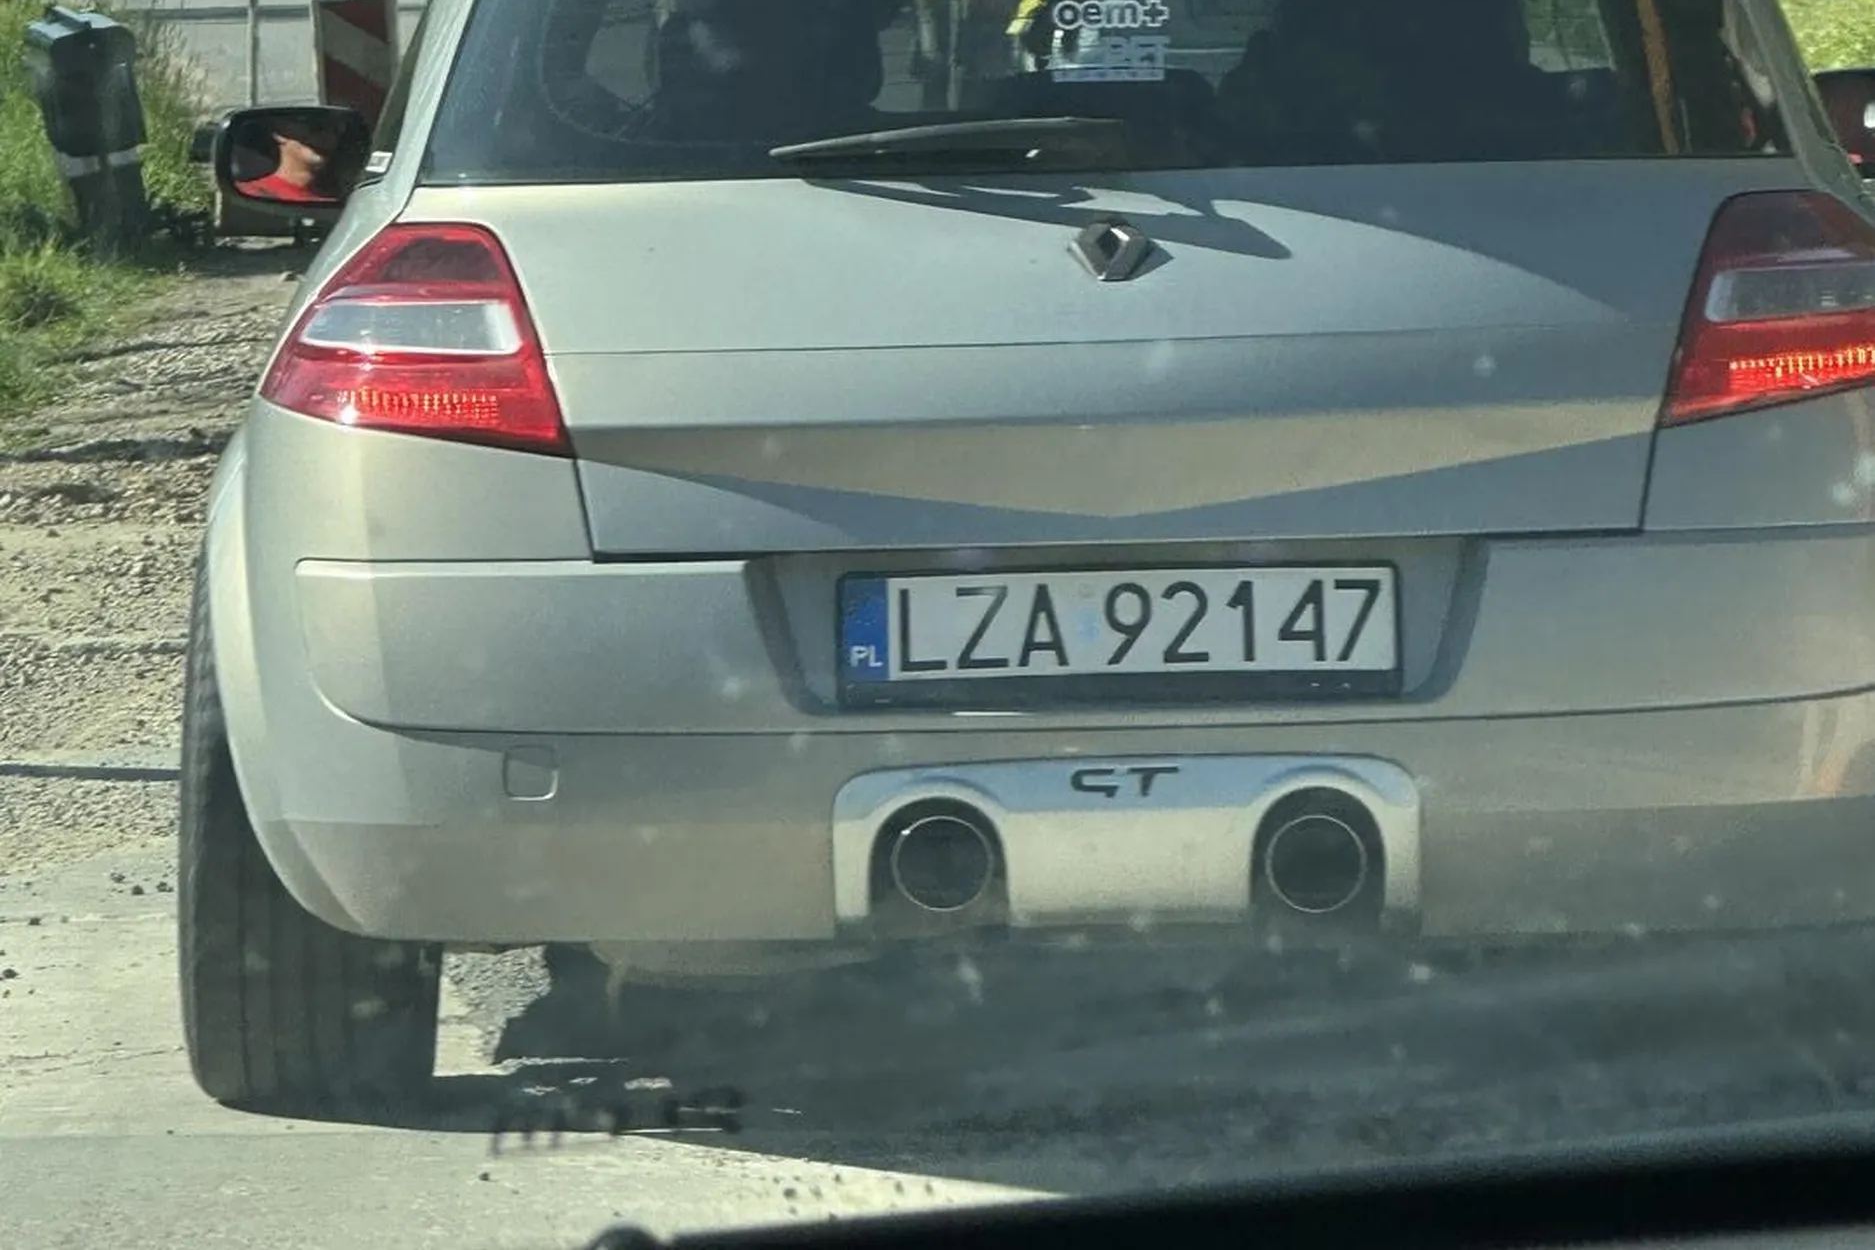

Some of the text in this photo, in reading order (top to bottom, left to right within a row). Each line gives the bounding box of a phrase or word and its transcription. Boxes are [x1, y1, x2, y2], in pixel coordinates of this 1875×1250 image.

[900, 579, 1381, 672] LZA 92147
[850, 647, 883, 667] PL
[1070, 766, 1180, 798] GT
